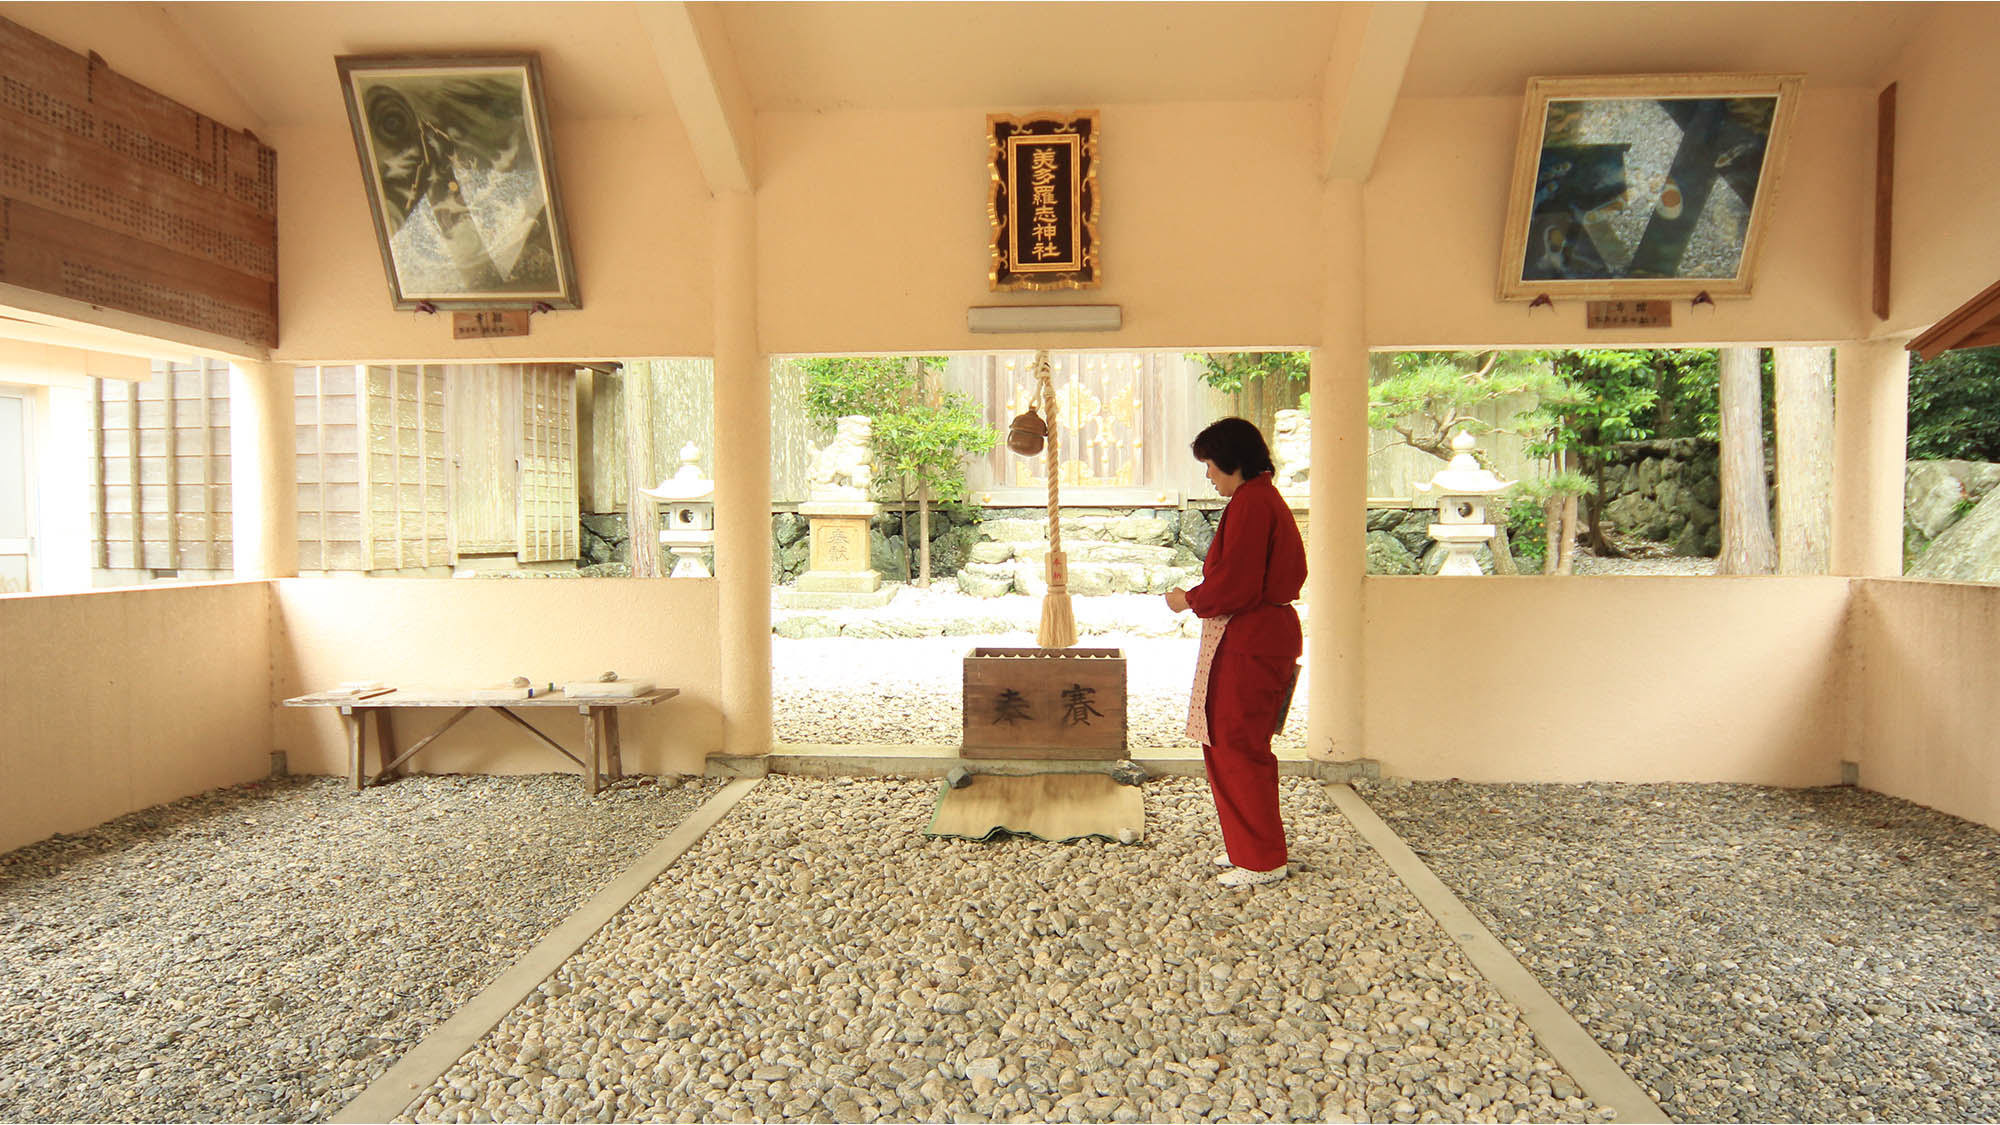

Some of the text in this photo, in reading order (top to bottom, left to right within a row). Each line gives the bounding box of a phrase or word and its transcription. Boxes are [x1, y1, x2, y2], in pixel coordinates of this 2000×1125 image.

[1031, 148, 1061, 261] 美多羅志神社
